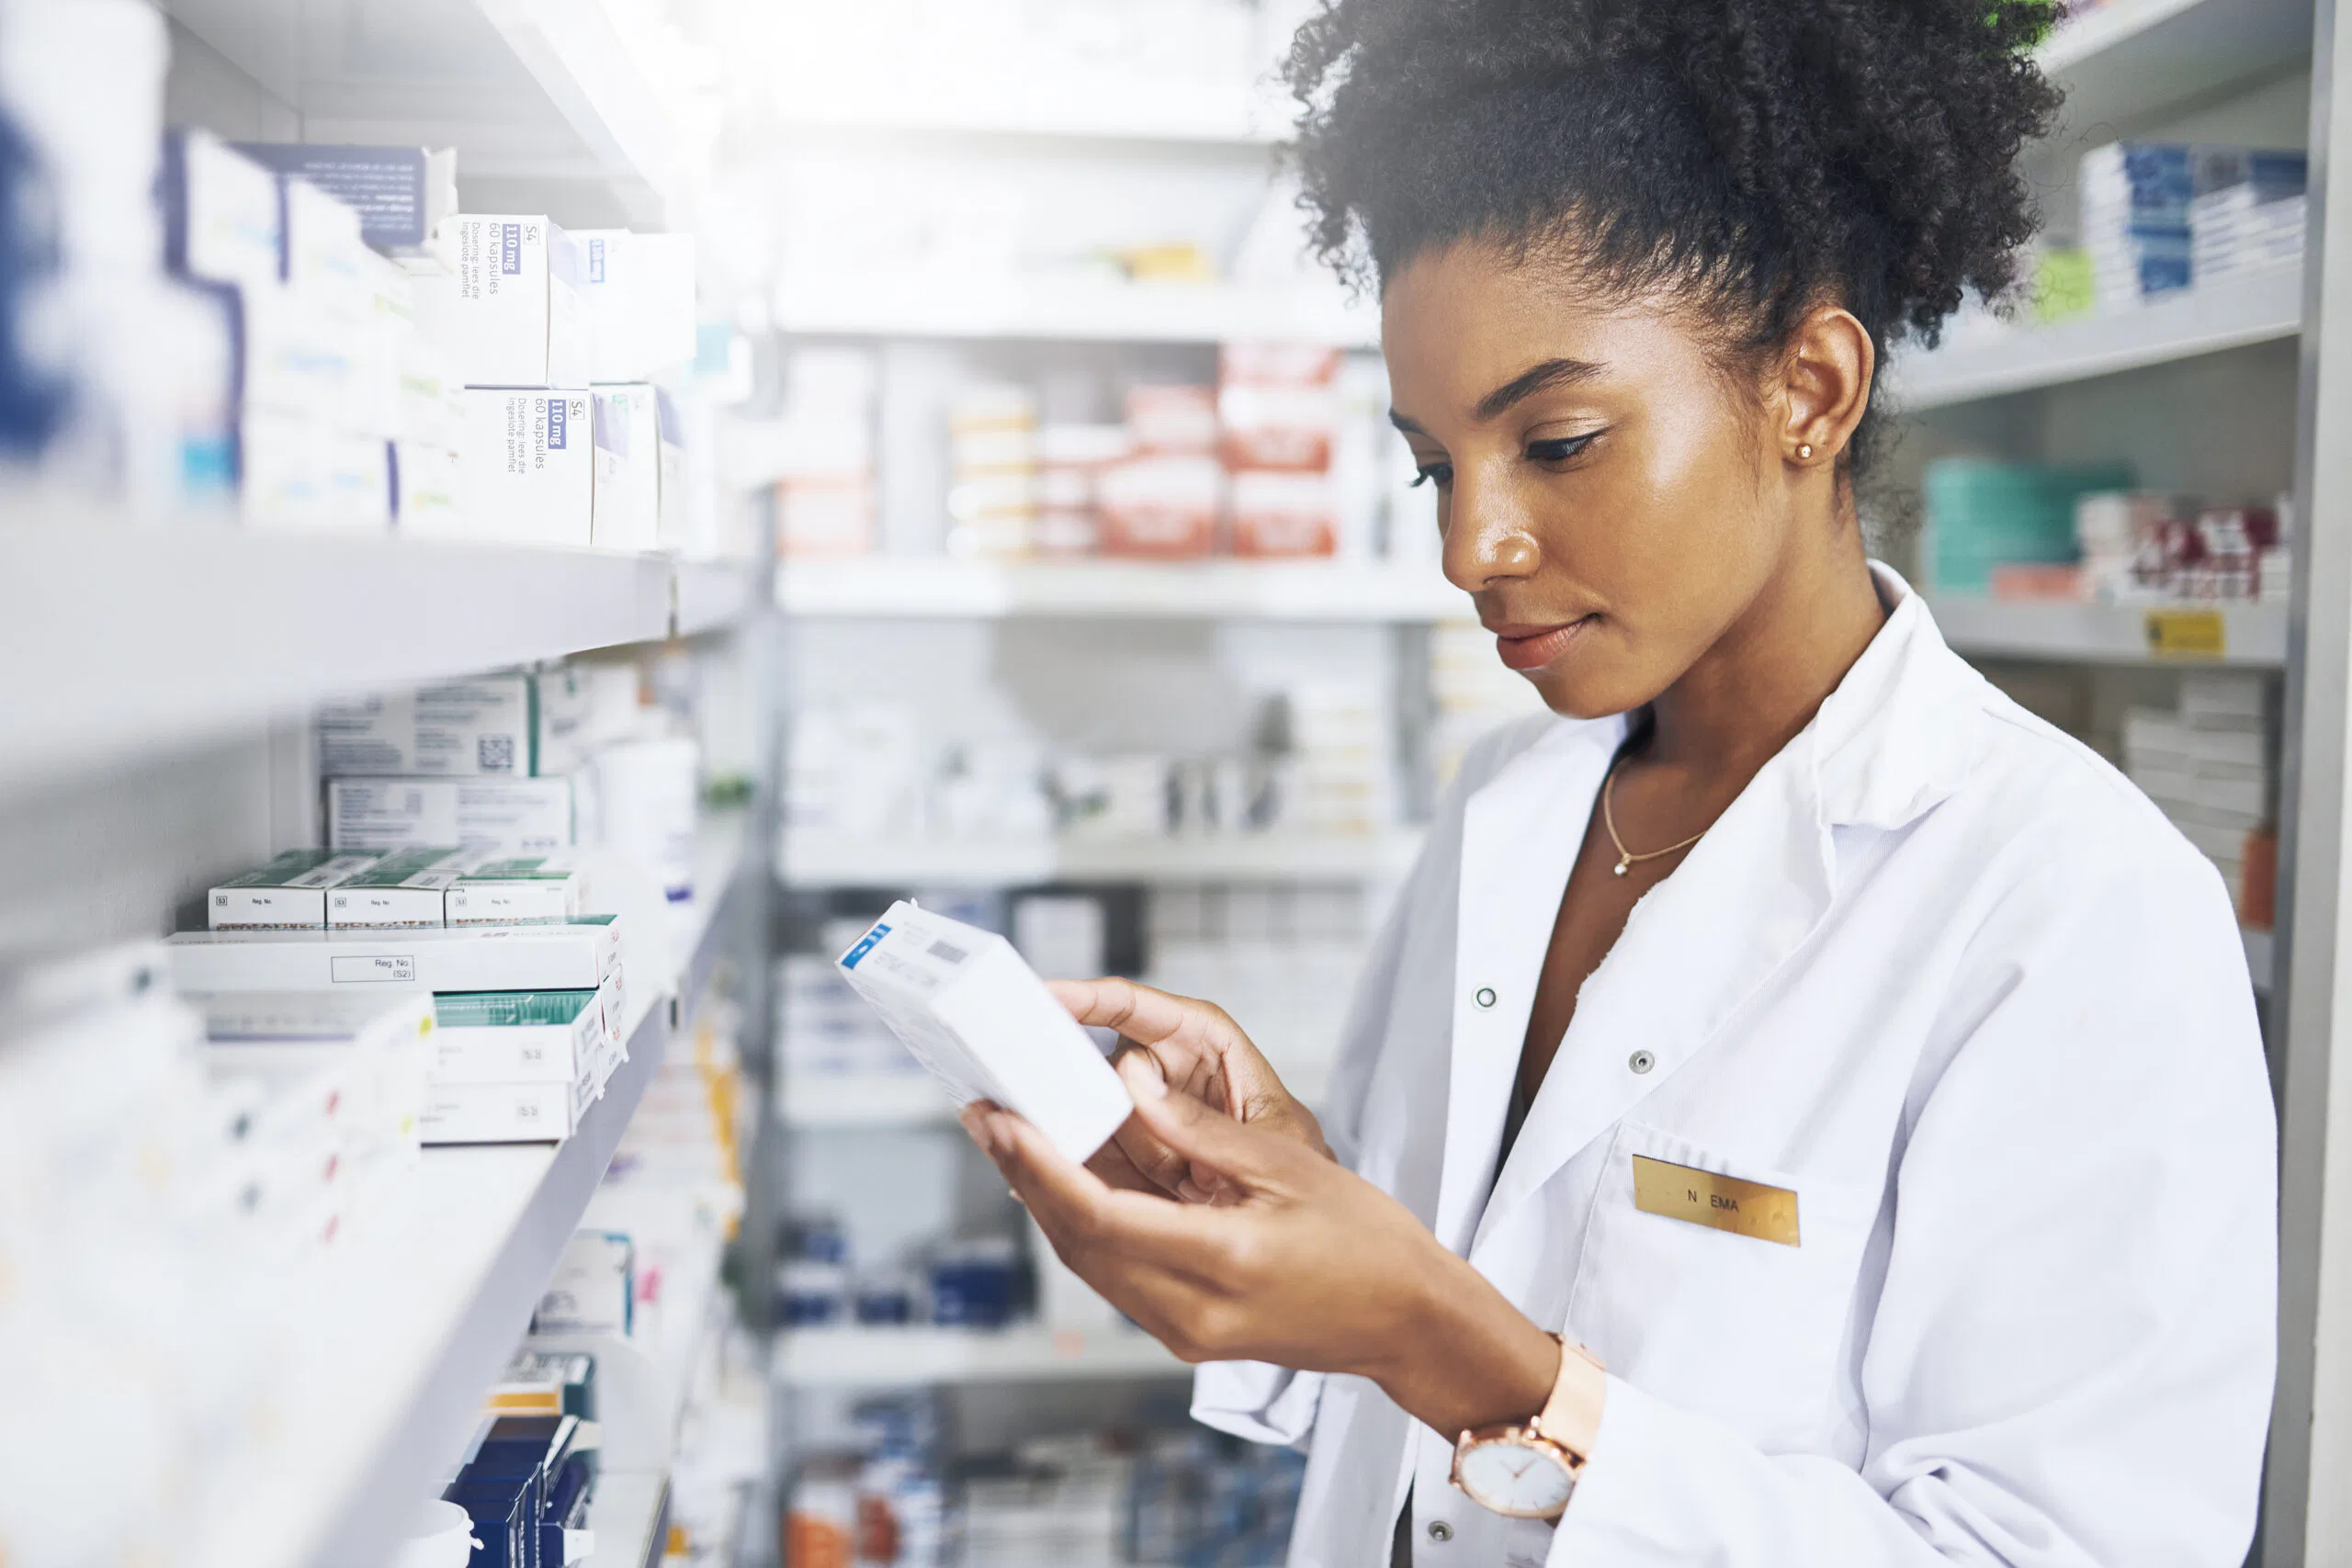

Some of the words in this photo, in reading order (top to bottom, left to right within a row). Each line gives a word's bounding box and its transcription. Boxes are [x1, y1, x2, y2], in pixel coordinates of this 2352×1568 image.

[490, 223, 500, 238] 60
[506, 226, 518, 247] 110
[526, 226, 537, 241] S4
[460, 221, 470, 262] ingeslote
[470, 222, 480, 263] Dosering:
[487, 242, 500, 294] kapsules
[504, 251, 515, 270] mg
[460, 264, 470, 298] pamflet
[472, 266, 480, 285] lees
[472, 286, 481, 299] die
[535, 398, 546, 413] 60
[552, 401, 563, 423] 110
[571, 401, 582, 416] S4
[506, 398, 516, 437] ingeslote
[516, 398, 526, 438] Dosering:
[533, 417, 546, 469] kapsules
[550, 426, 561, 446] mg
[506, 439, 517, 473] pamflet
[518, 441, 526, 459] lees
[518, 460, 526, 474] die
[1688, 1189, 1697, 1203] N
[1710, 1194, 1739, 1213] EMA
